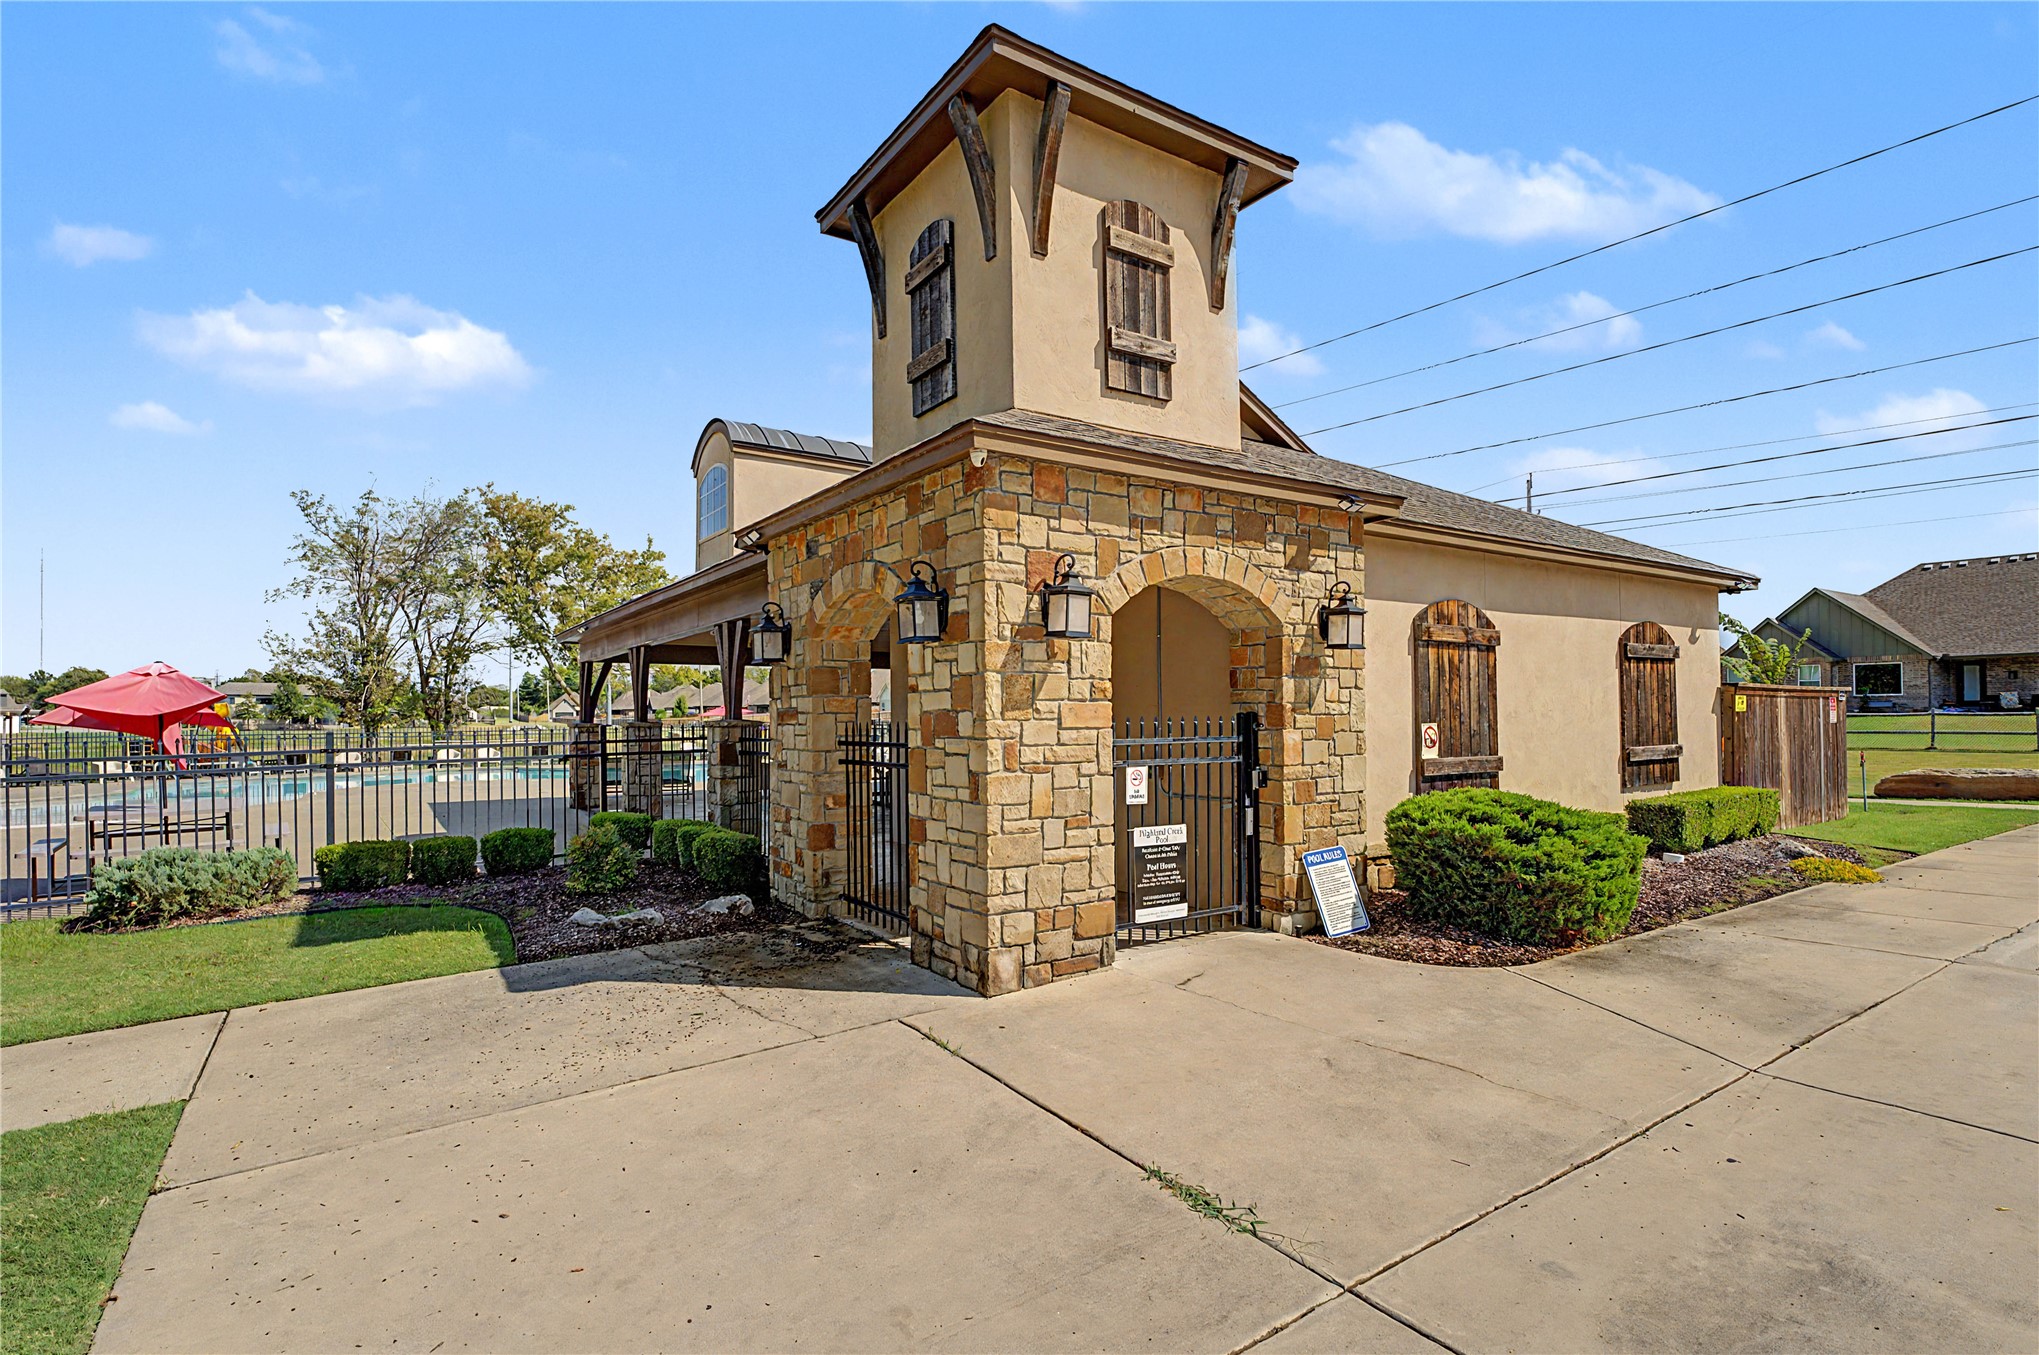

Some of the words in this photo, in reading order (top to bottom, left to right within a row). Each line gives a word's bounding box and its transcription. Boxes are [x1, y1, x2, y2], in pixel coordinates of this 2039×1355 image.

[1139, 828, 1166, 839] Highland
[1167, 827, 1184, 836] Creek
[1155, 836, 1169, 844] Pool
[1307, 853, 1325, 864] POOL
[1323, 849, 1343, 861] RULES
[1146, 863, 1159, 871] Pool
